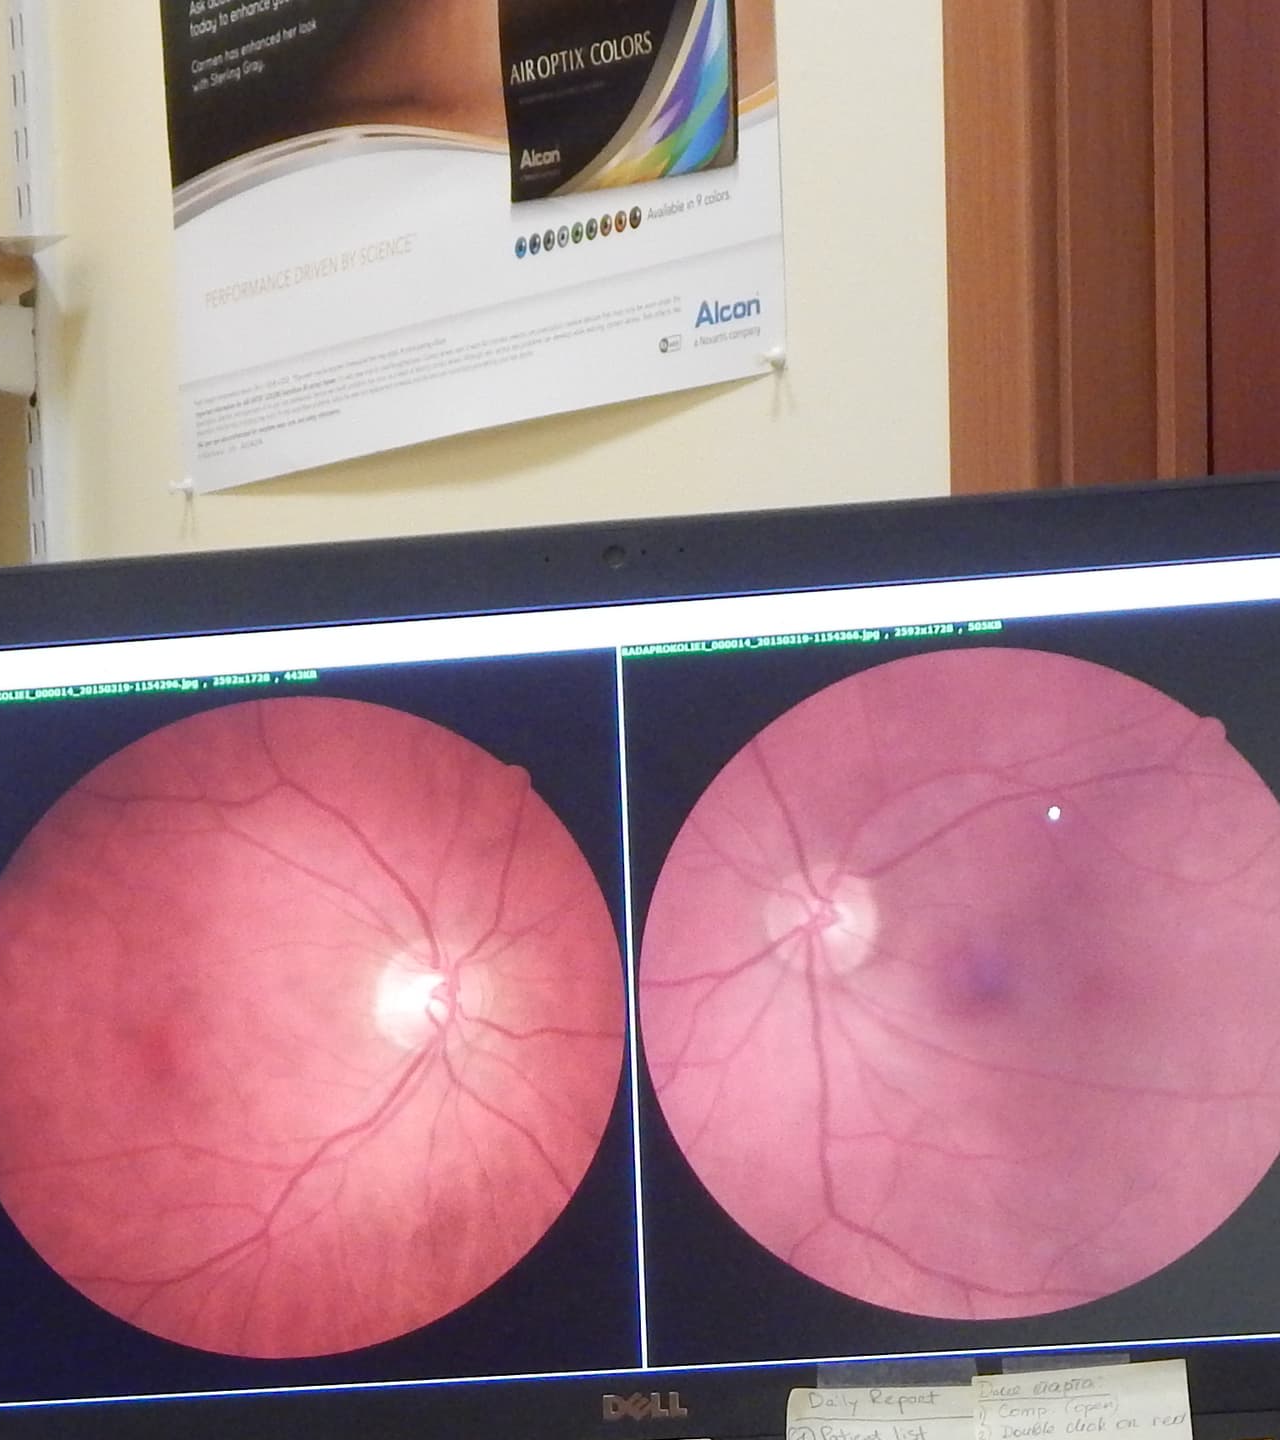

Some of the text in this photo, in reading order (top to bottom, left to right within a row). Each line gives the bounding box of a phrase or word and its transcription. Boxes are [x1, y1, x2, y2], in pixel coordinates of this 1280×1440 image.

[189, 1, 270, 37] today to enhance
[191, 54, 223, 74] Carmen
[241, 30, 281, 56] enhanced
[299, 17, 317, 34] look
[510, 30, 653, 86] AIR OPTIX COLORS
[520, 148, 561, 170] Alcon
[647, 200, 684, 221] Available
[687, 199, 695, 210] in
[204, 266, 291, 309] PERFORMANCE
[293, 255, 337, 285] DRIVEN
[340, 248, 356, 272] BY
[695, 298, 761, 328] Alcon
[728, 326, 761, 342] company
[894, 624, 953, 637] 2592x1728
[968, 620, 1002, 632] 505KB
[213, 673, 270, 685] 2592x1728
[283, 669, 317, 681] 443KB
[602, 1391, 688, 1421] DELL
[809, 1388, 940, 1416] Daily Report
[1002, 1422, 1056, 1439] Double
[1116, 1418, 1140, 1429] on
[1151, 1412, 1187, 1427] red
